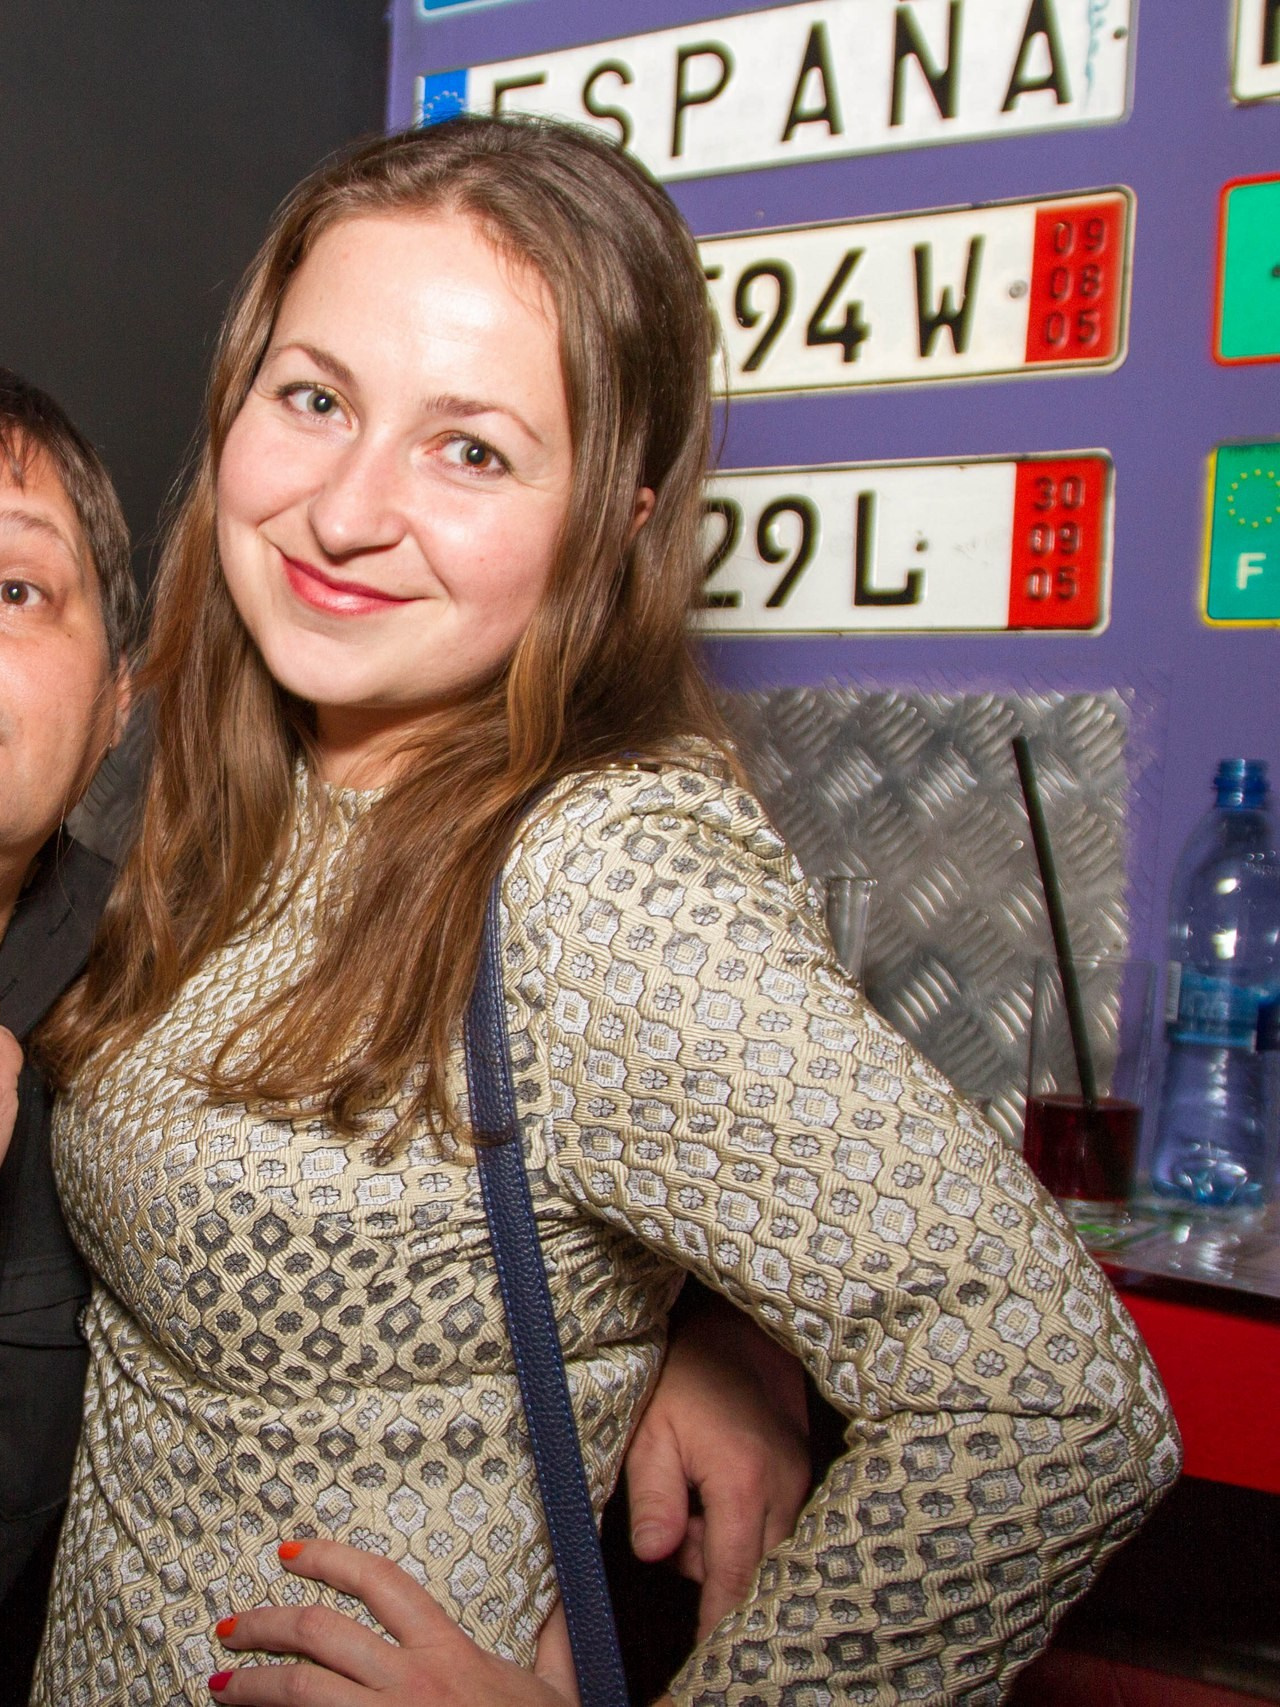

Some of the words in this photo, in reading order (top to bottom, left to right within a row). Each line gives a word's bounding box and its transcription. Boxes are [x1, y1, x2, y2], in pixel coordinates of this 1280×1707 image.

[1053, 217, 1106, 255] 09
[705, 247, 870, 372] 94
[913, 233, 986, 358] W
[1046, 308, 1099, 346] 05
[1034, 475, 1086, 511] 30
[1236, 552, 1266, 590] F
